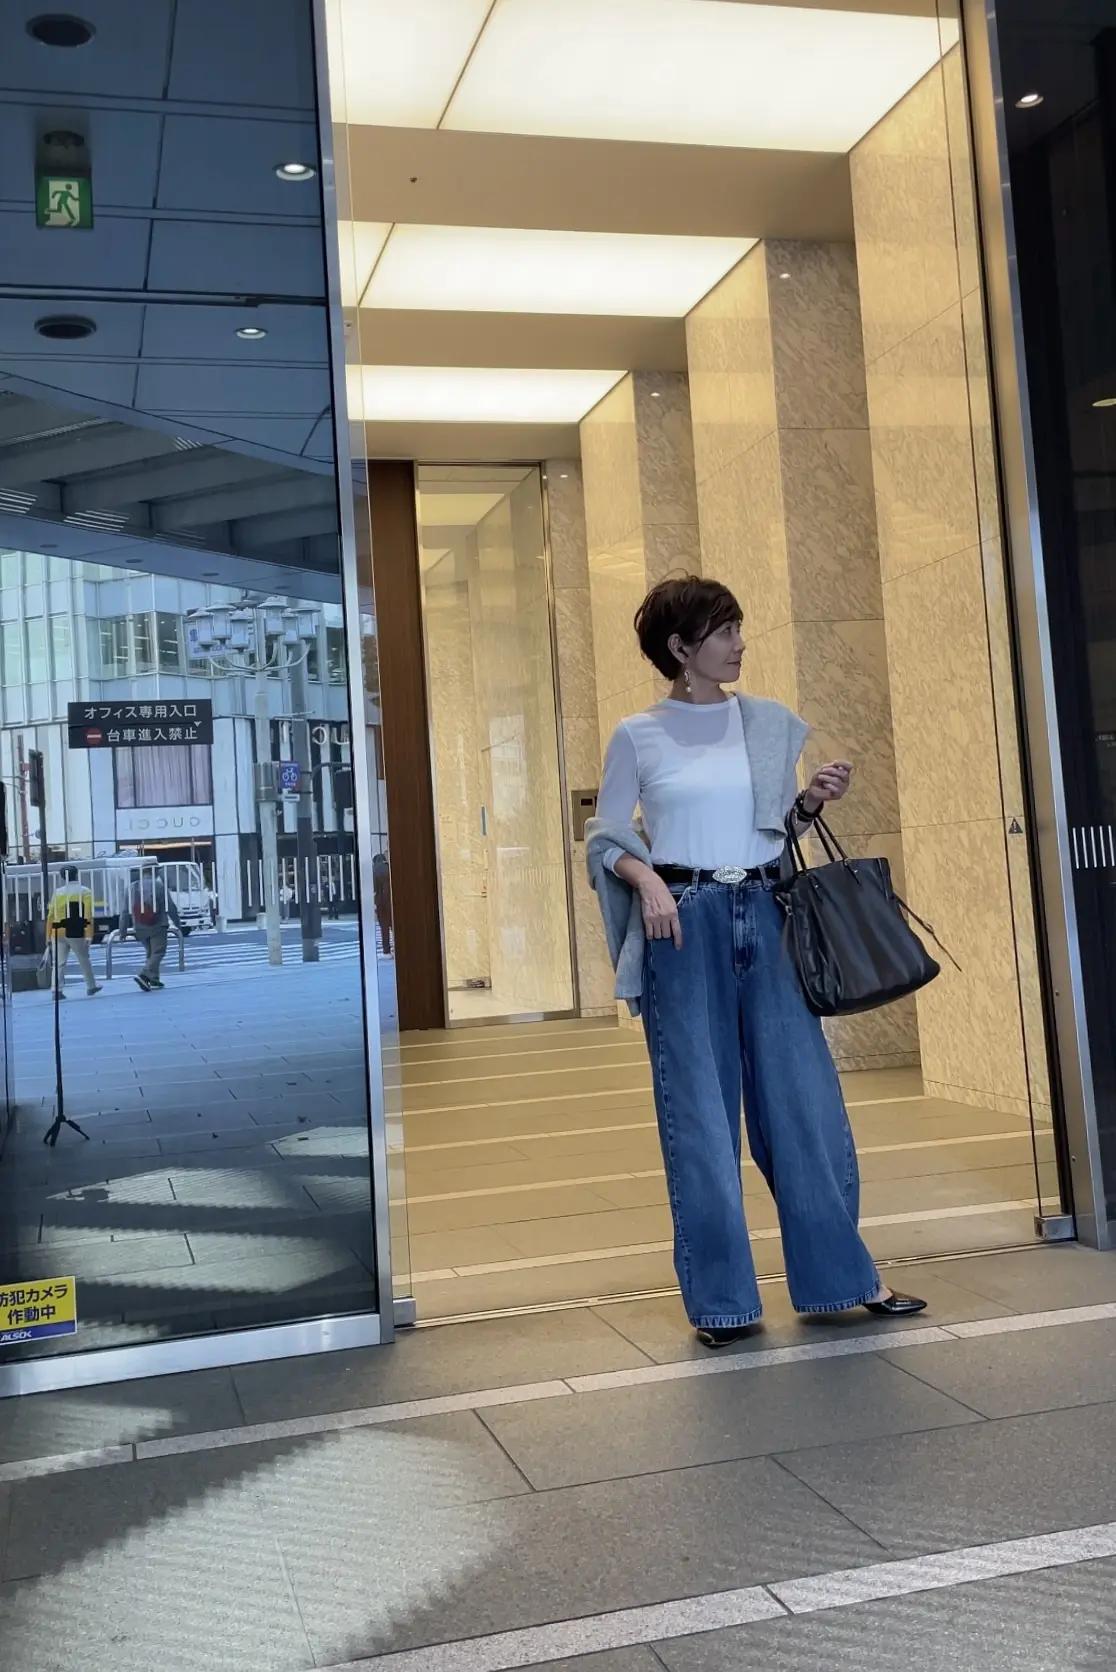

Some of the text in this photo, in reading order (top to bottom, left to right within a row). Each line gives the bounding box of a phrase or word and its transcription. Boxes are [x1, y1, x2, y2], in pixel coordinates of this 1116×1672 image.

[84, 704, 197, 720] オフィス専用入口
[106, 726, 198, 743] 台車進入禁止
[7, 1304, 56, 1325] 作動中
[0, 1330, 32, 1342] ALSOK
